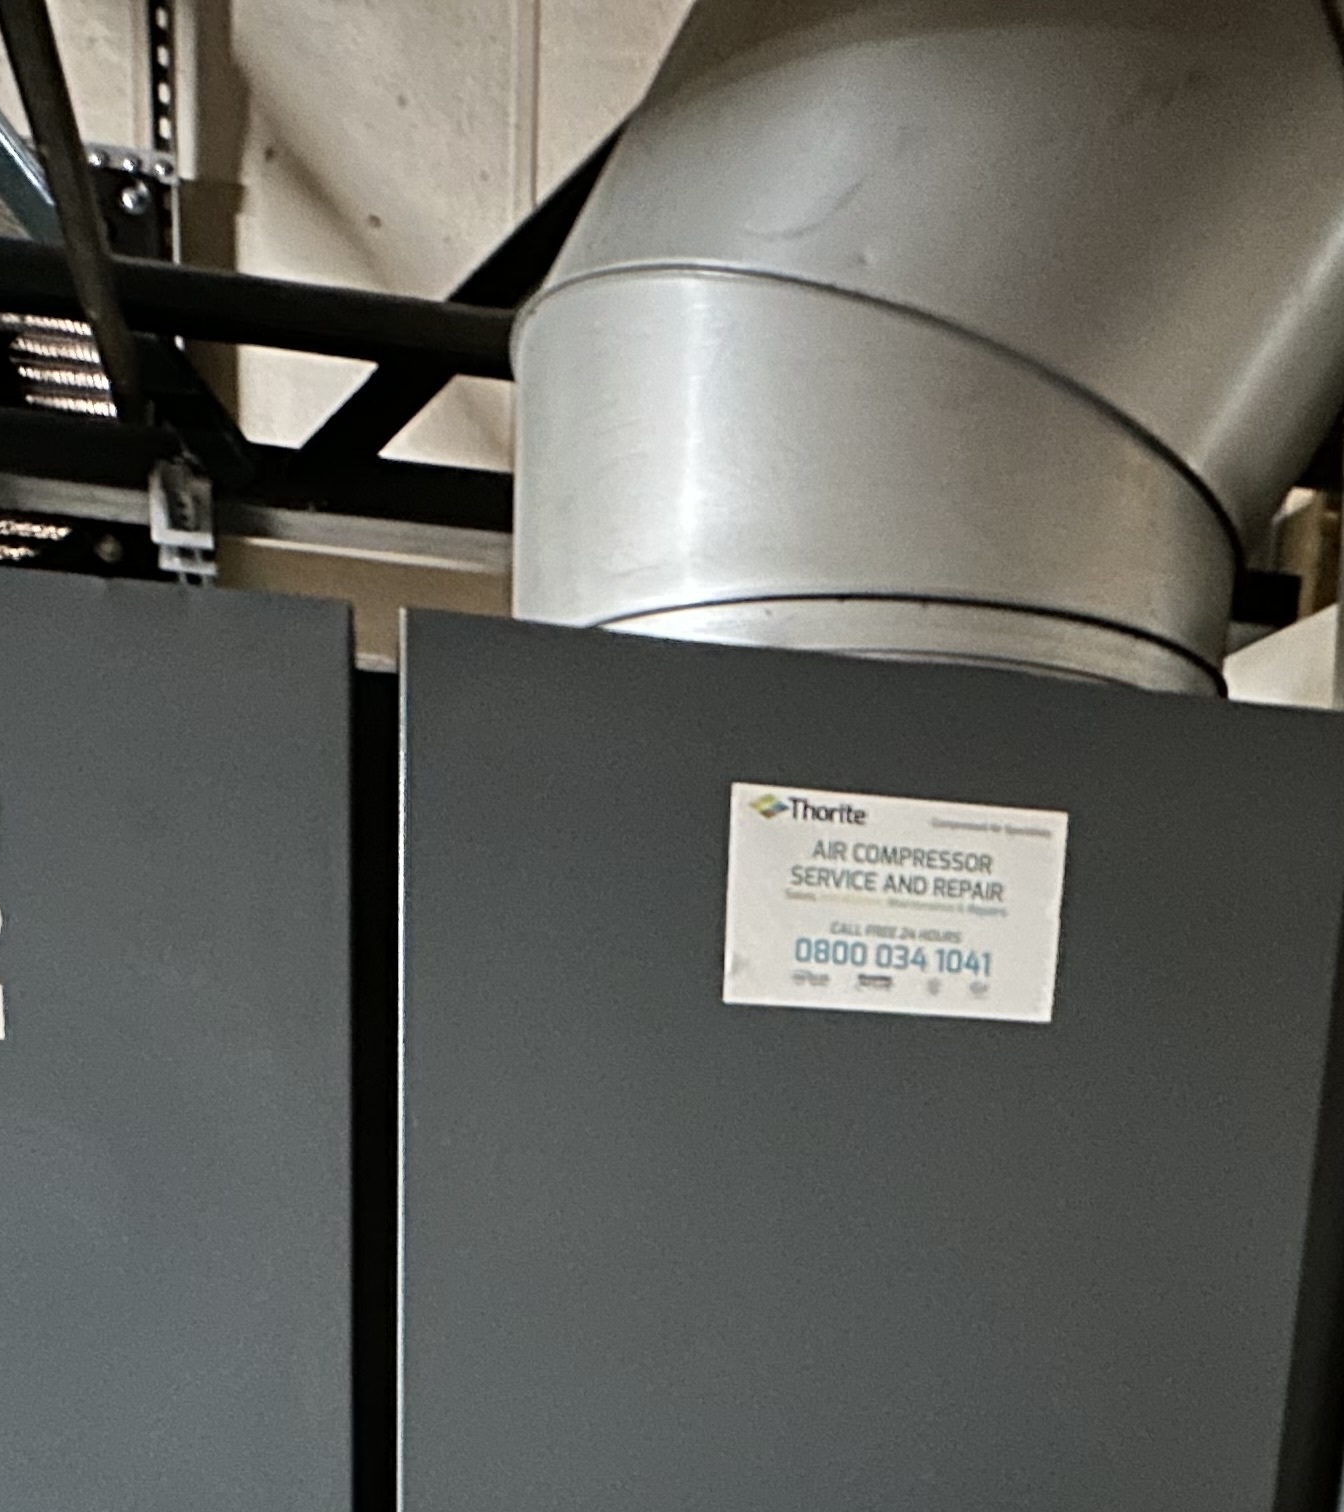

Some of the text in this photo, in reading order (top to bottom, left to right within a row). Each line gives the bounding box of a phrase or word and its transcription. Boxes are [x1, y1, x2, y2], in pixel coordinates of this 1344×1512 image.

[788, 797, 867, 825] Thorite
[811, 839, 993, 874] AIR COMPRESSOR
[790, 864, 1005, 902] SERVICE AND REPAIR
[830, 921, 963, 944] CALL FREE 24 HOURS
[794, 937, 992, 977] 0800 034 1041
